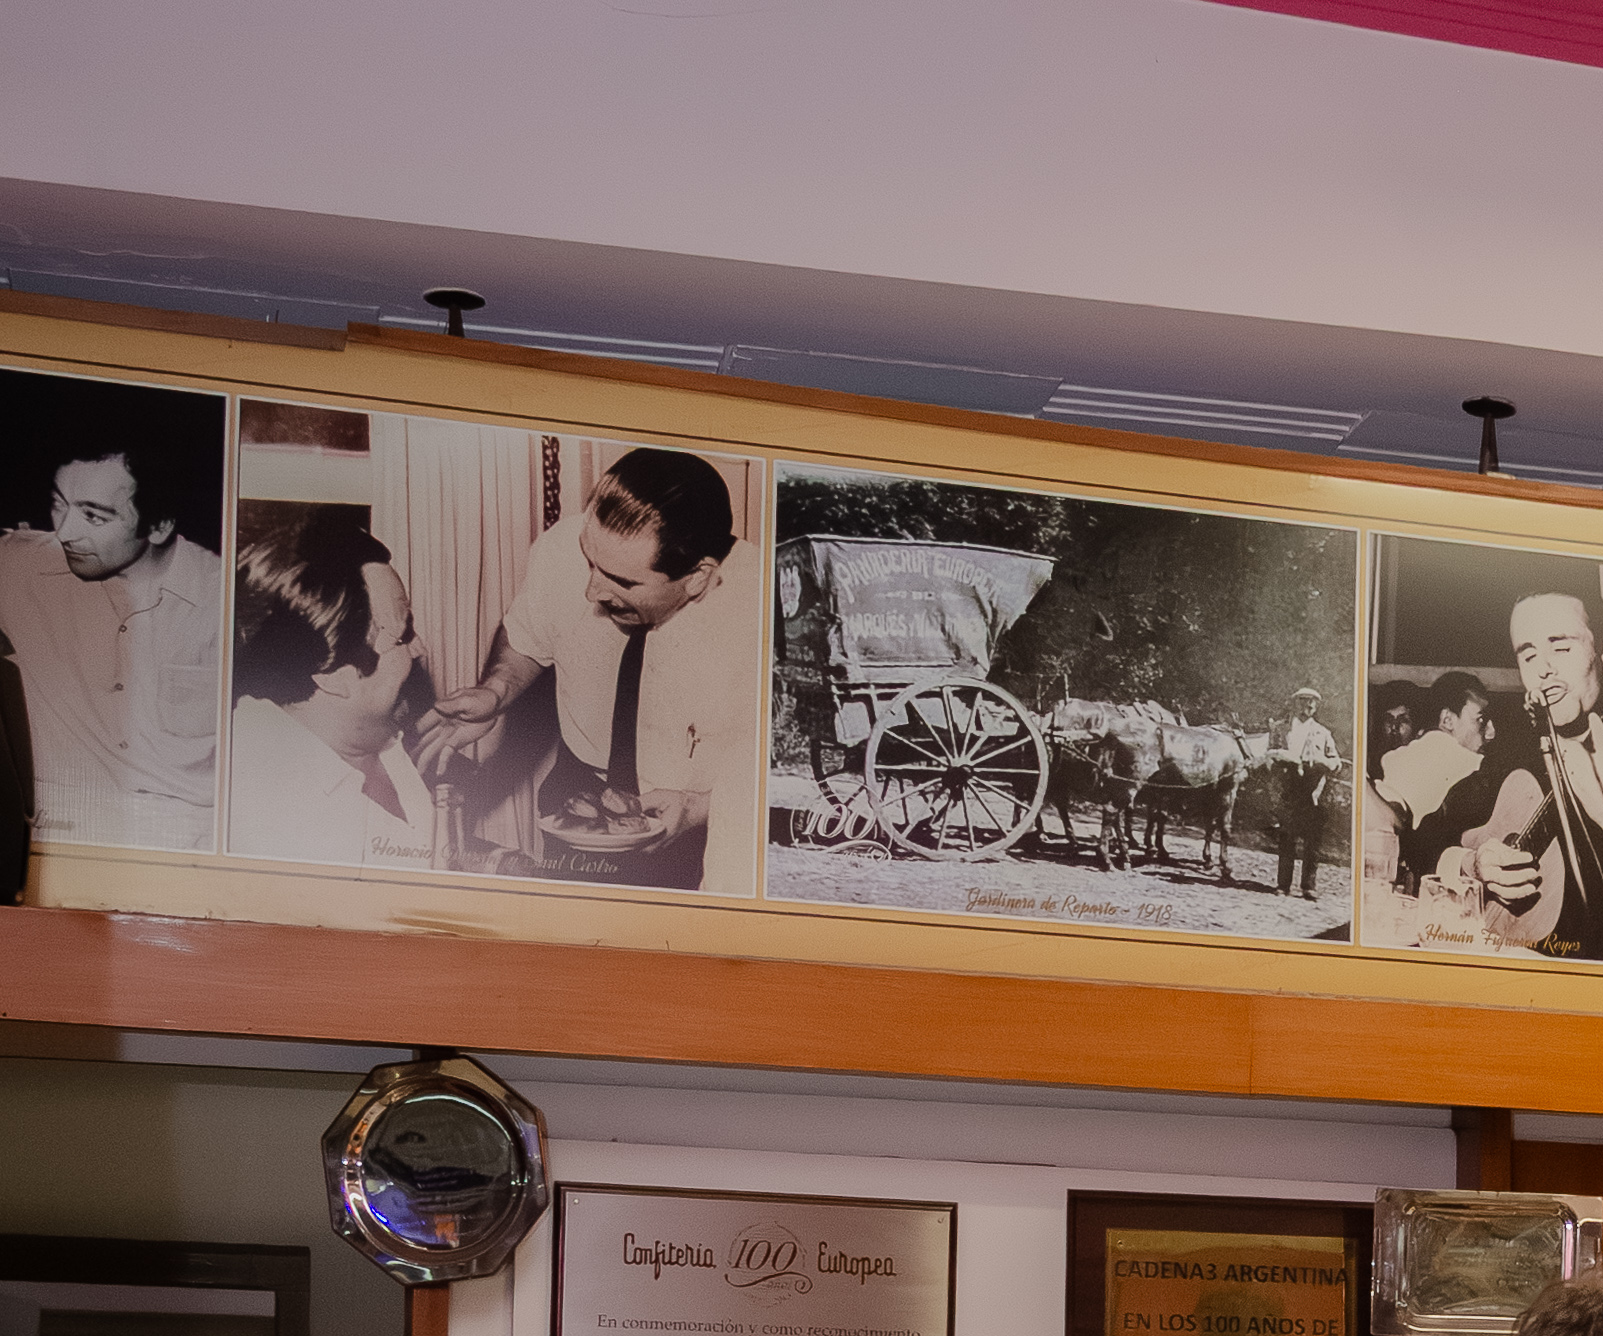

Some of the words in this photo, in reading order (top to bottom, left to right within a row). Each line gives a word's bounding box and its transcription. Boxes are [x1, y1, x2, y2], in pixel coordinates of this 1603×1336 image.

[569, 854, 619, 875] Castro
[1040, 895, 1057, 912] de
[1061, 894, 1116, 918] Reparto
[1137, 903, 1173, 923] 1918
[1425, 924, 1474, 944] Hernán
[1543, 933, 1581, 956] Reyes
[623, 1232, 717, 1281] Confitería
[732, 1238, 798, 1272] 100
[817, 1241, 897, 1285] Europea
[1224, 1264, 1348, 1287] ARGENTINA
[597, 1313, 617, 1329] En
[622, 1316, 744, 1336] conmemoración
[762, 1323, 803, 1336] como
[1123, 1312, 1150, 1330] EN
[1159, 1314, 1197, 1332] LOS
[1203, 1315, 1240, 1332] 100
[1312, 1319, 1339, 1336] DE
